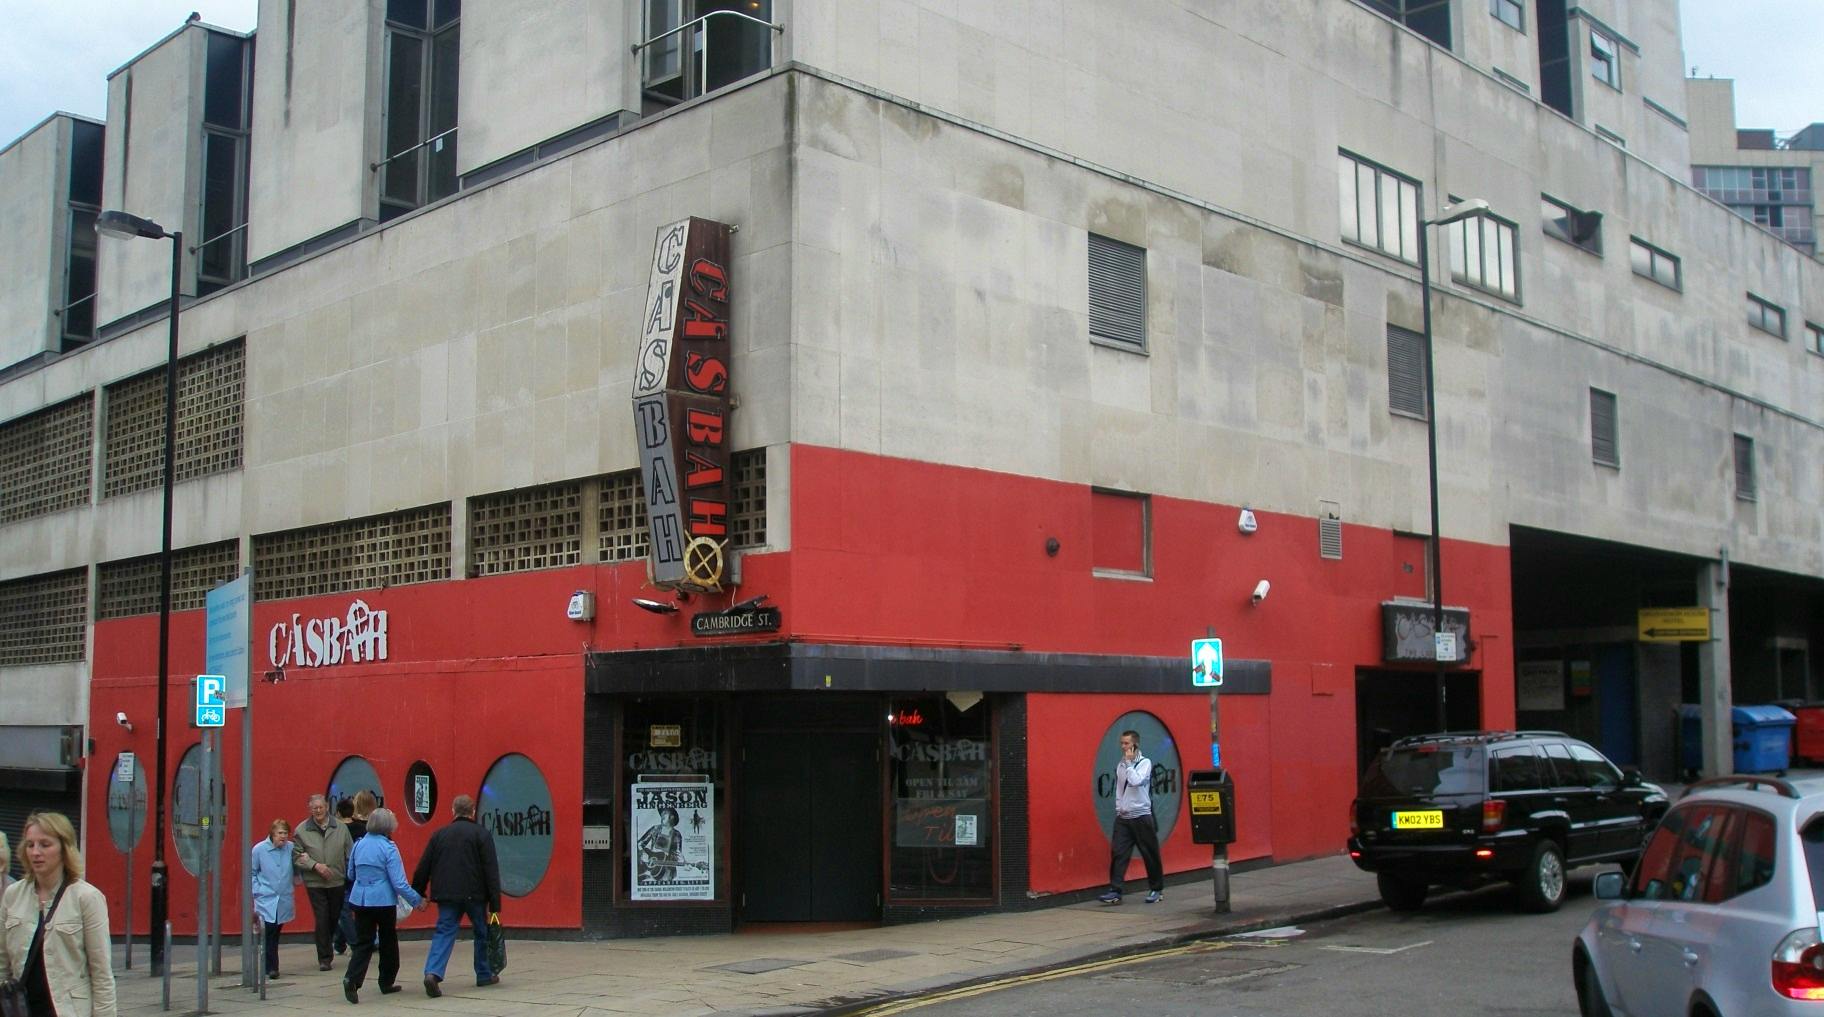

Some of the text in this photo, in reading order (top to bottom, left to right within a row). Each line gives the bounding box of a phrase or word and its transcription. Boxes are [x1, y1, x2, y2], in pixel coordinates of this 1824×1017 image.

[639, 225, 684, 564] CASBAH
[682, 257, 731, 536] CASBAH
[696, 612, 772, 630] CAMBRIDGE ST.
[269, 599, 388, 668] CASBAH
[204, 680, 220, 704] P
[629, 747, 717, 770] CASBAH
[898, 739, 985, 762] CASBAH
[906, 778, 932, 786] OPEN
[637, 789, 707, 804] JASON
[637, 799, 707, 810] RINGENBERG
[916, 789, 934, 799] FRI
[949, 789, 968, 799] SAT
[481, 804, 551, 837] CASBAH
[1398, 815, 1441, 825] KM02 YBS
